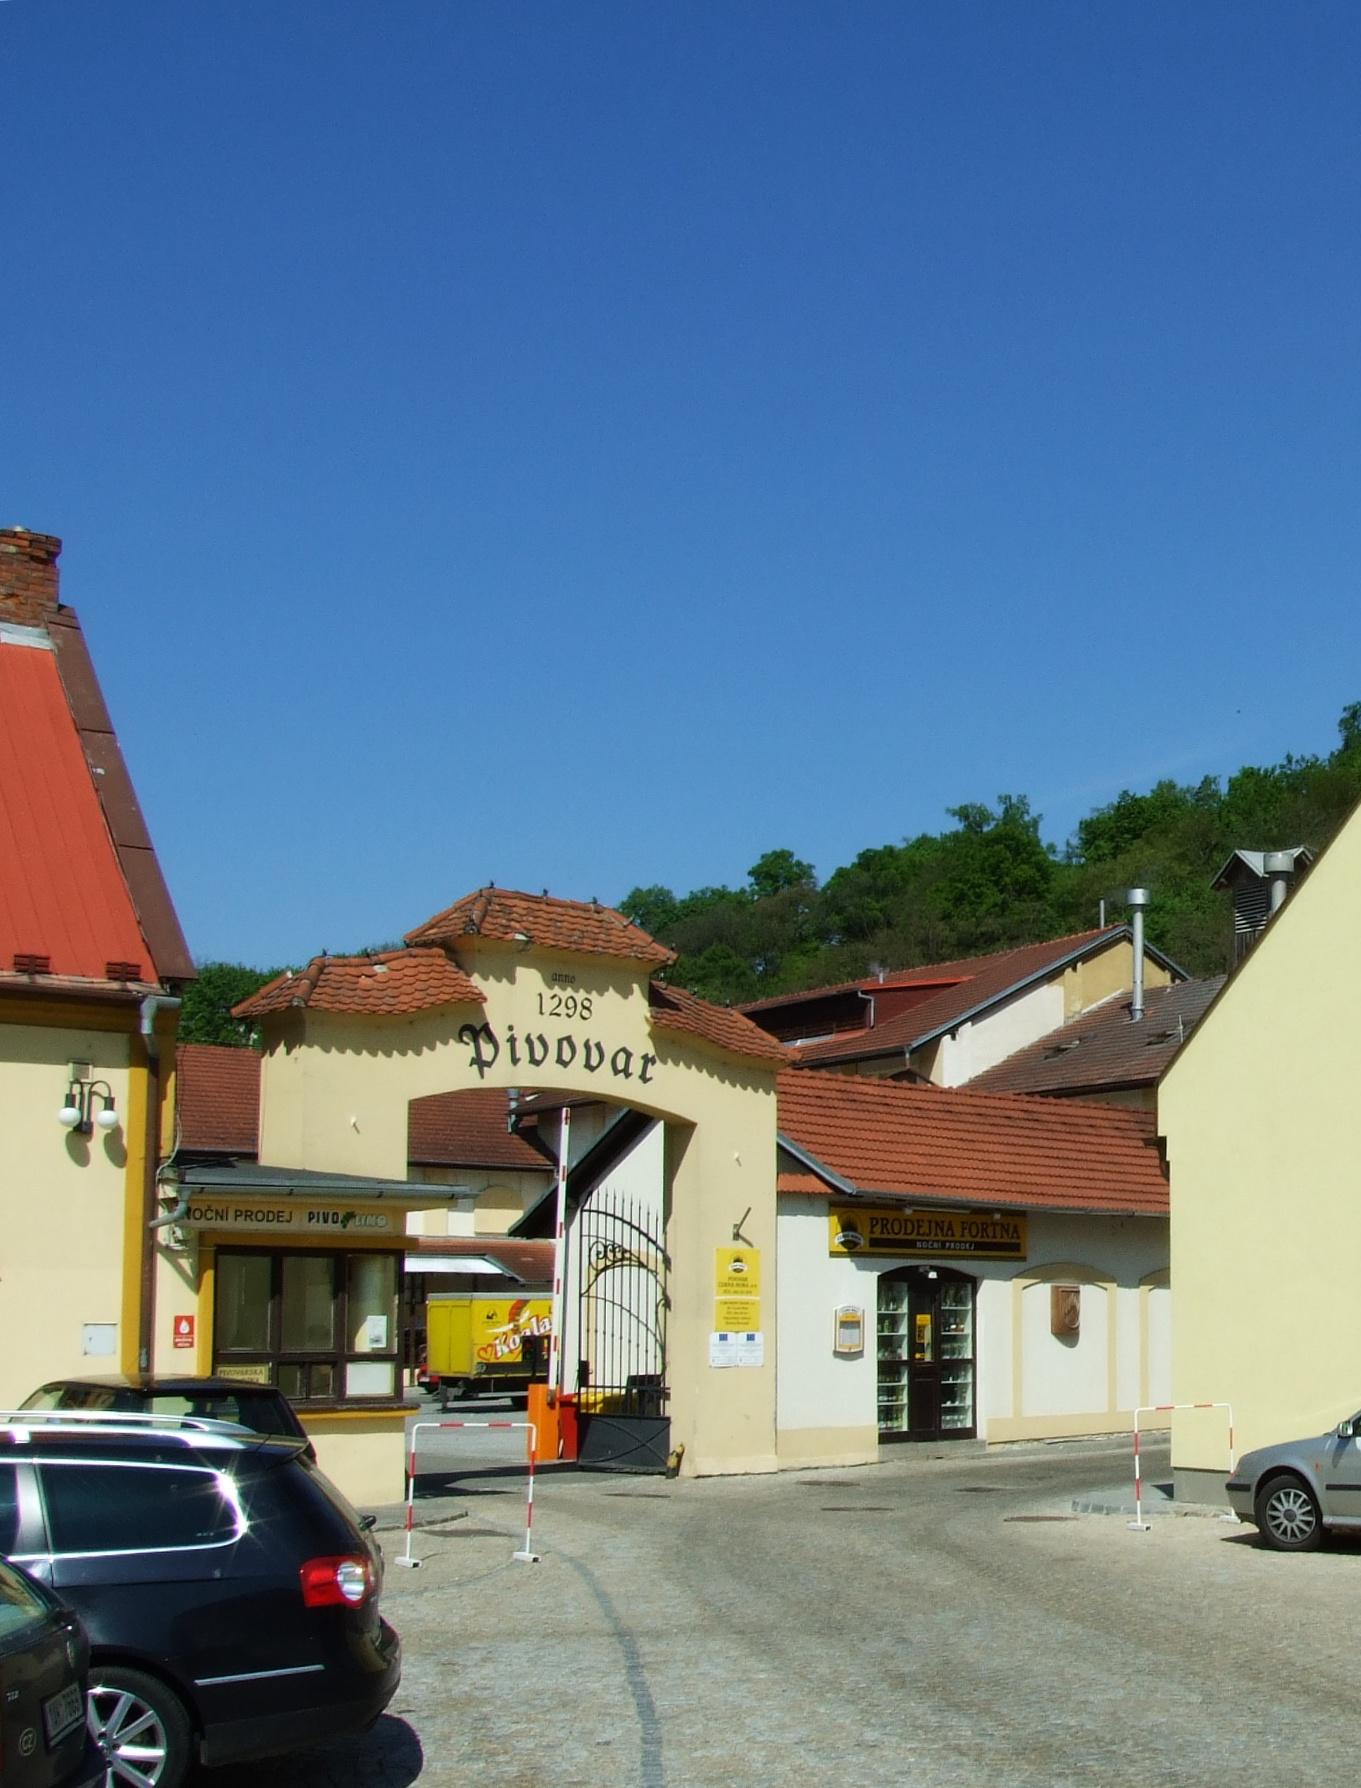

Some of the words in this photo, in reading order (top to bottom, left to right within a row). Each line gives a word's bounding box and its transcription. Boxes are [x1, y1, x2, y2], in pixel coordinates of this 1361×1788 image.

[551, 971, 577, 985] anno
[537, 992, 594, 1021] 1298
[458, 1021, 657, 1085] Pivovar
[234, 1208, 293, 1224] PRODEJ
[307, 1210, 340, 1225] PIVO
[868, 1216, 956, 1238] PRODEJNA
[960, 1220, 1021, 1240] FORTNA
